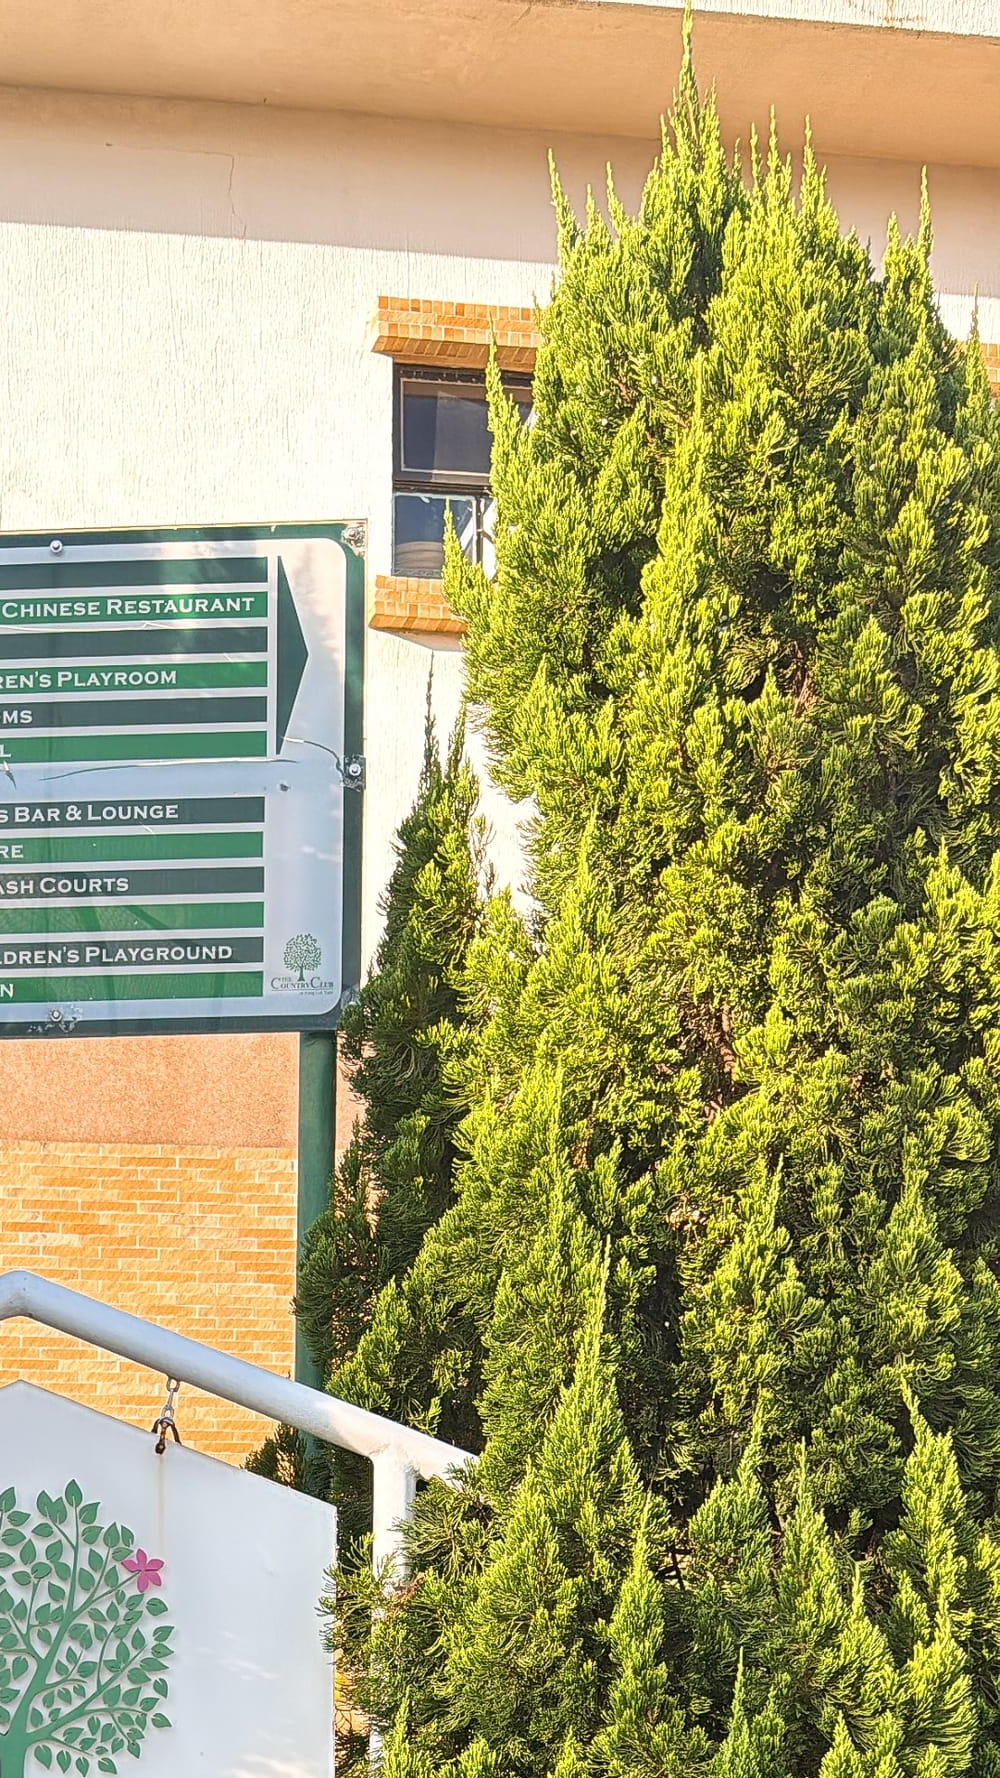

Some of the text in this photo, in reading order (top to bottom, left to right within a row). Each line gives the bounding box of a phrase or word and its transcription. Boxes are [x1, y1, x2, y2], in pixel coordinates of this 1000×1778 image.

[2, 601, 100, 618] CHINESE
[106, 597, 255, 615] RESTAURANT
[57, 670, 177, 688] PLAYROOM
[14, 806, 61, 823] BAR
[65, 804, 82, 822] &
[88, 803, 179, 821] LOUNGE
[40, 877, 129, 895] COURTS
[86, 945, 233, 963] PLAYGROUND
